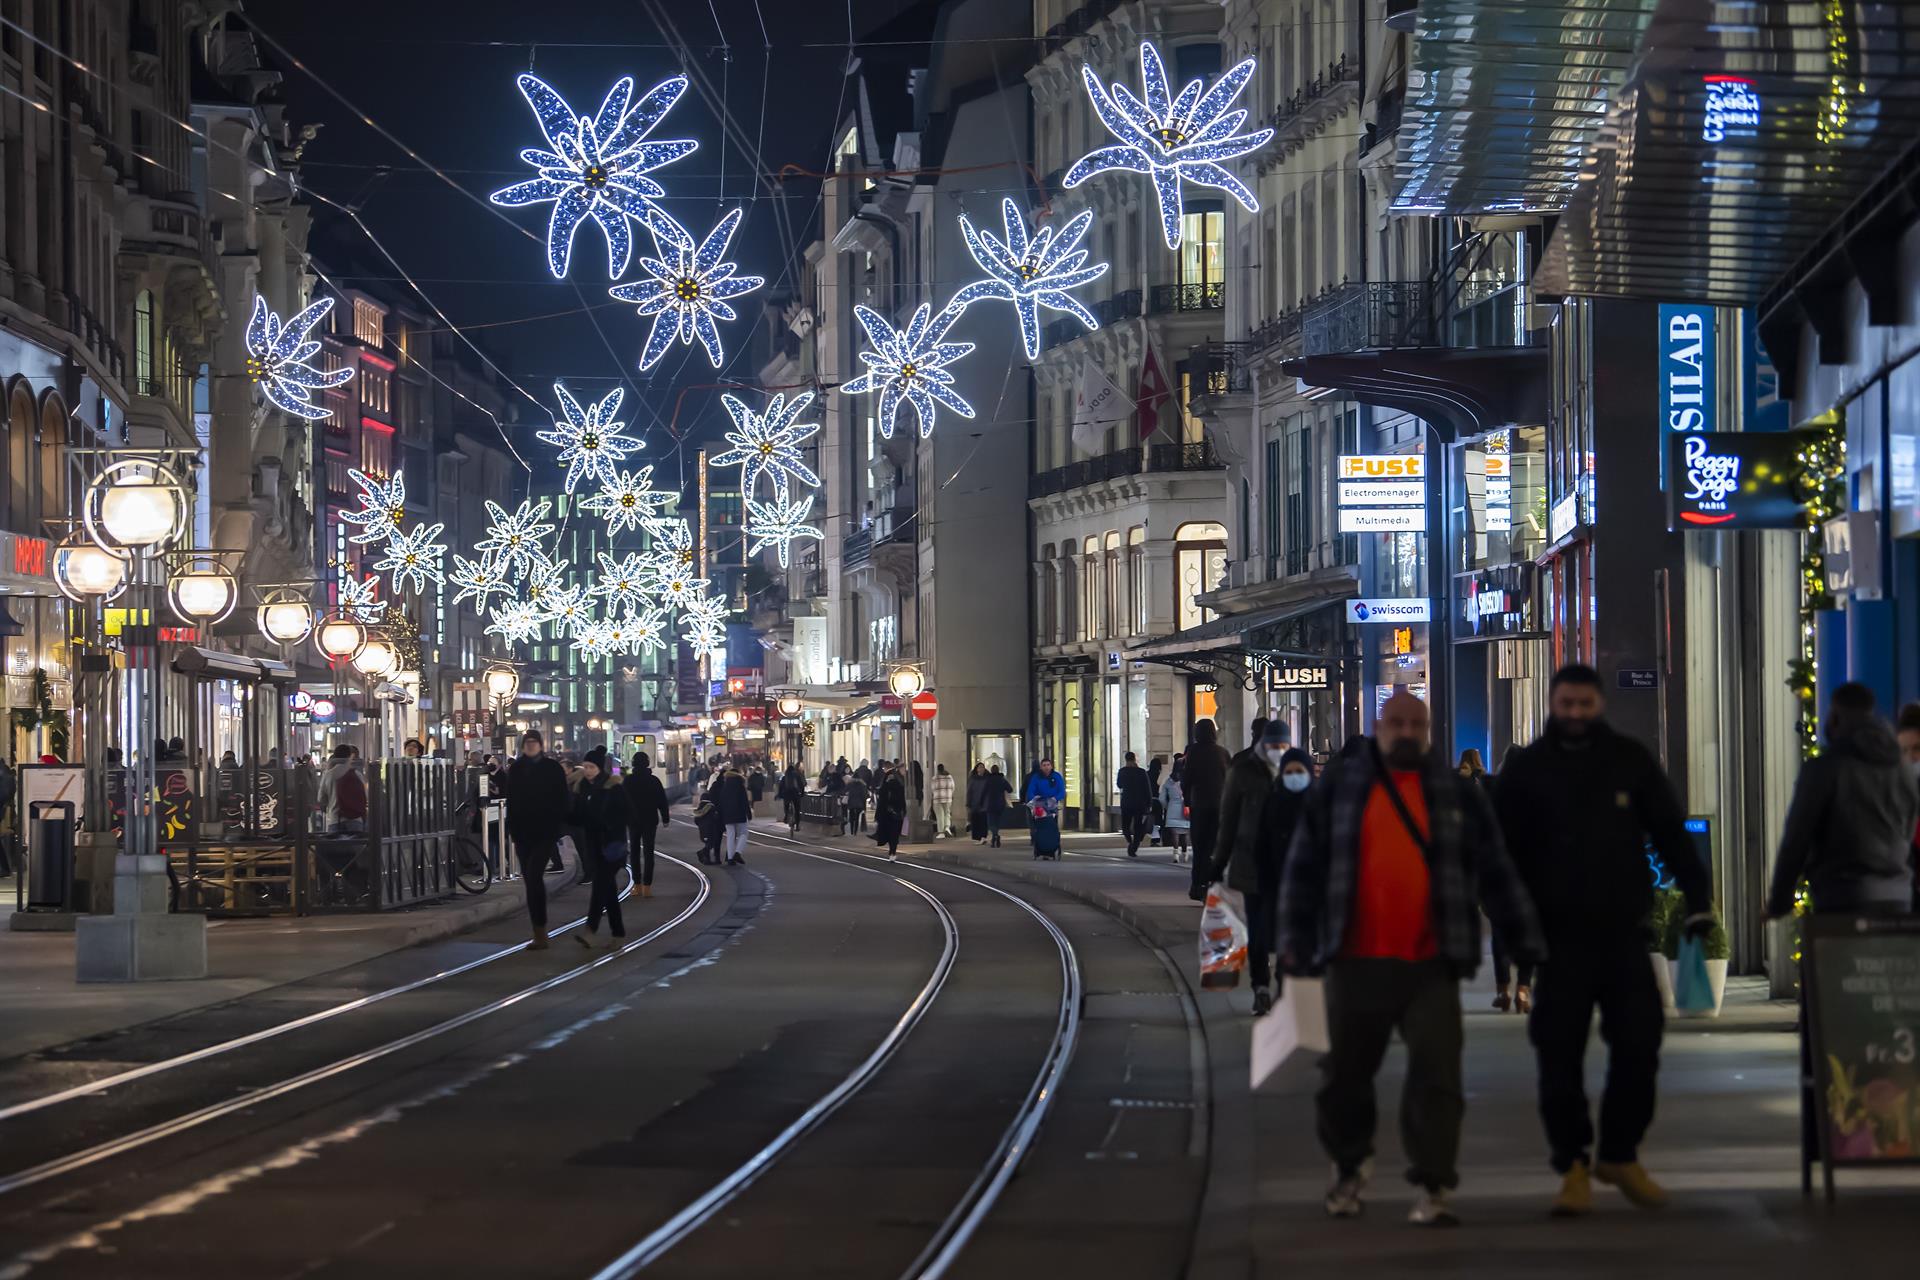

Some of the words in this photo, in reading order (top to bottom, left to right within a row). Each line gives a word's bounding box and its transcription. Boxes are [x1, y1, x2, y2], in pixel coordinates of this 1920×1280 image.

[1345, 457, 1420, 476] Fust
[1684, 436, 1740, 478] Peggy
[1684, 469, 1738, 501] Sage
[1698, 502, 1727, 510] PARIS
[1372, 604, 1424, 615] swisscom
[1273, 668, 1327, 684] LUSH
[1893, 1028, 1915, 1064] 3
